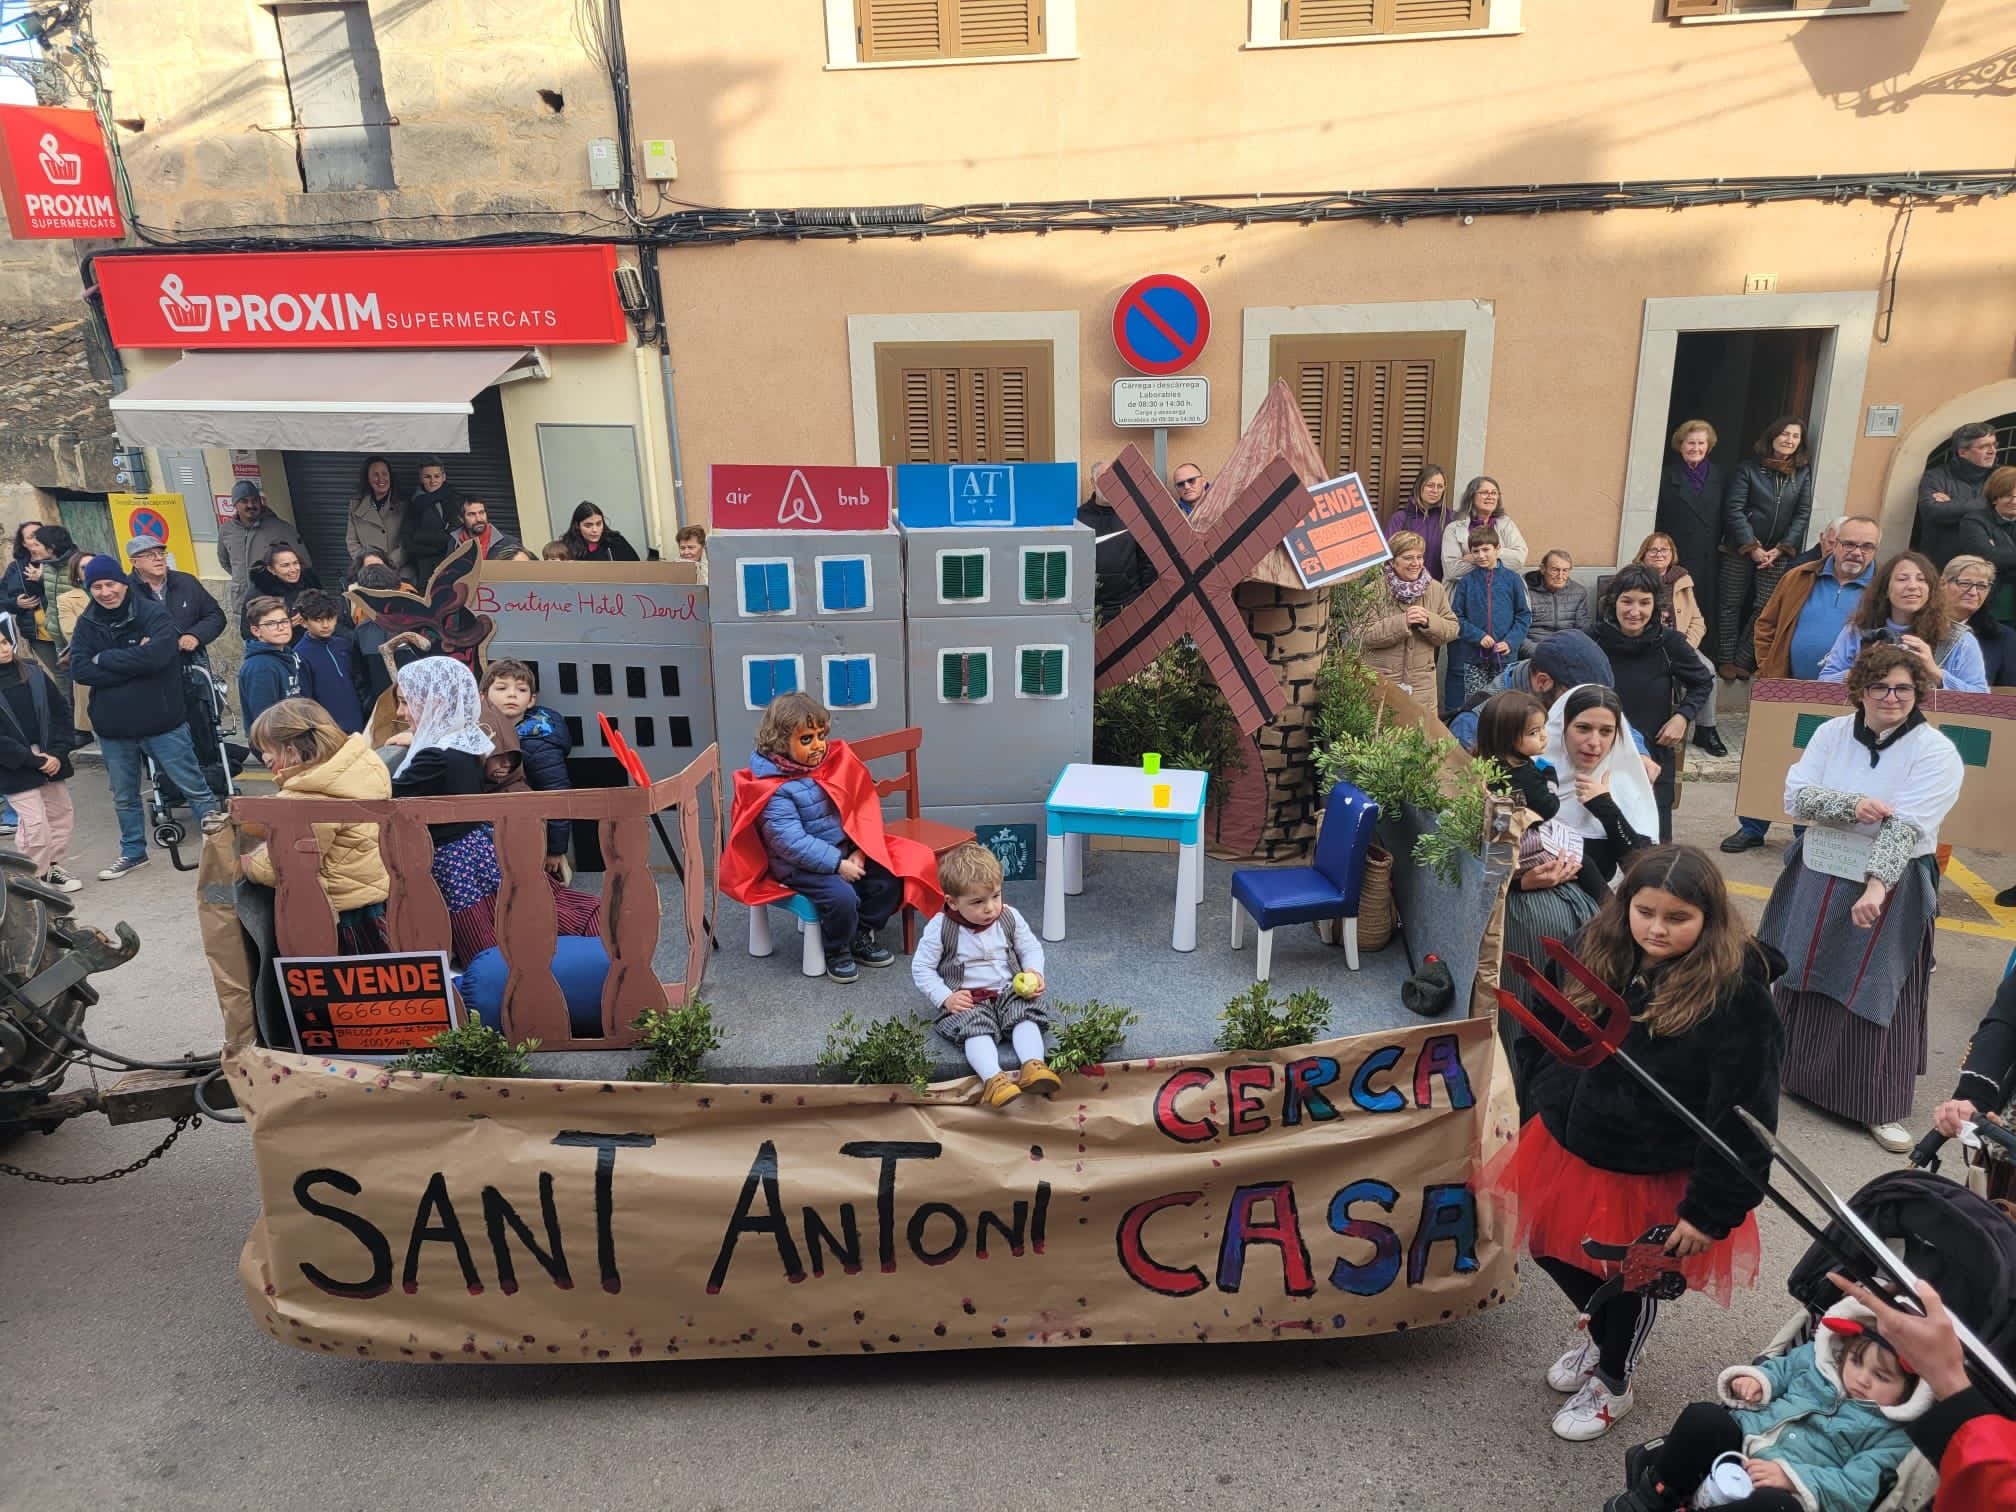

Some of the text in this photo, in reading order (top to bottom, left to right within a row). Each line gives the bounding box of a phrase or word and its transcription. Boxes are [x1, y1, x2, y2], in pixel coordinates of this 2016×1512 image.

[25, 194, 114, 217] PROXIM
[31, 218, 117, 229] SUPERMERCATS
[1754, 279, 1769, 290] 11
[215, 293, 558, 332] PROXIM SUPERMERCATS
[1127, 400, 1137, 408] de
[725, 487, 870, 507] air bnb
[961, 471, 1003, 497] AT
[473, 587, 573, 621] Boutique
[577, 591, 627, 617] Hotel
[287, 963, 442, 997] SE VENDE
[1153, 1034, 1476, 1143] CERCA
[293, 1130, 1052, 1298] SANT ANTONI
[1116, 1179, 1480, 1299] CASA
